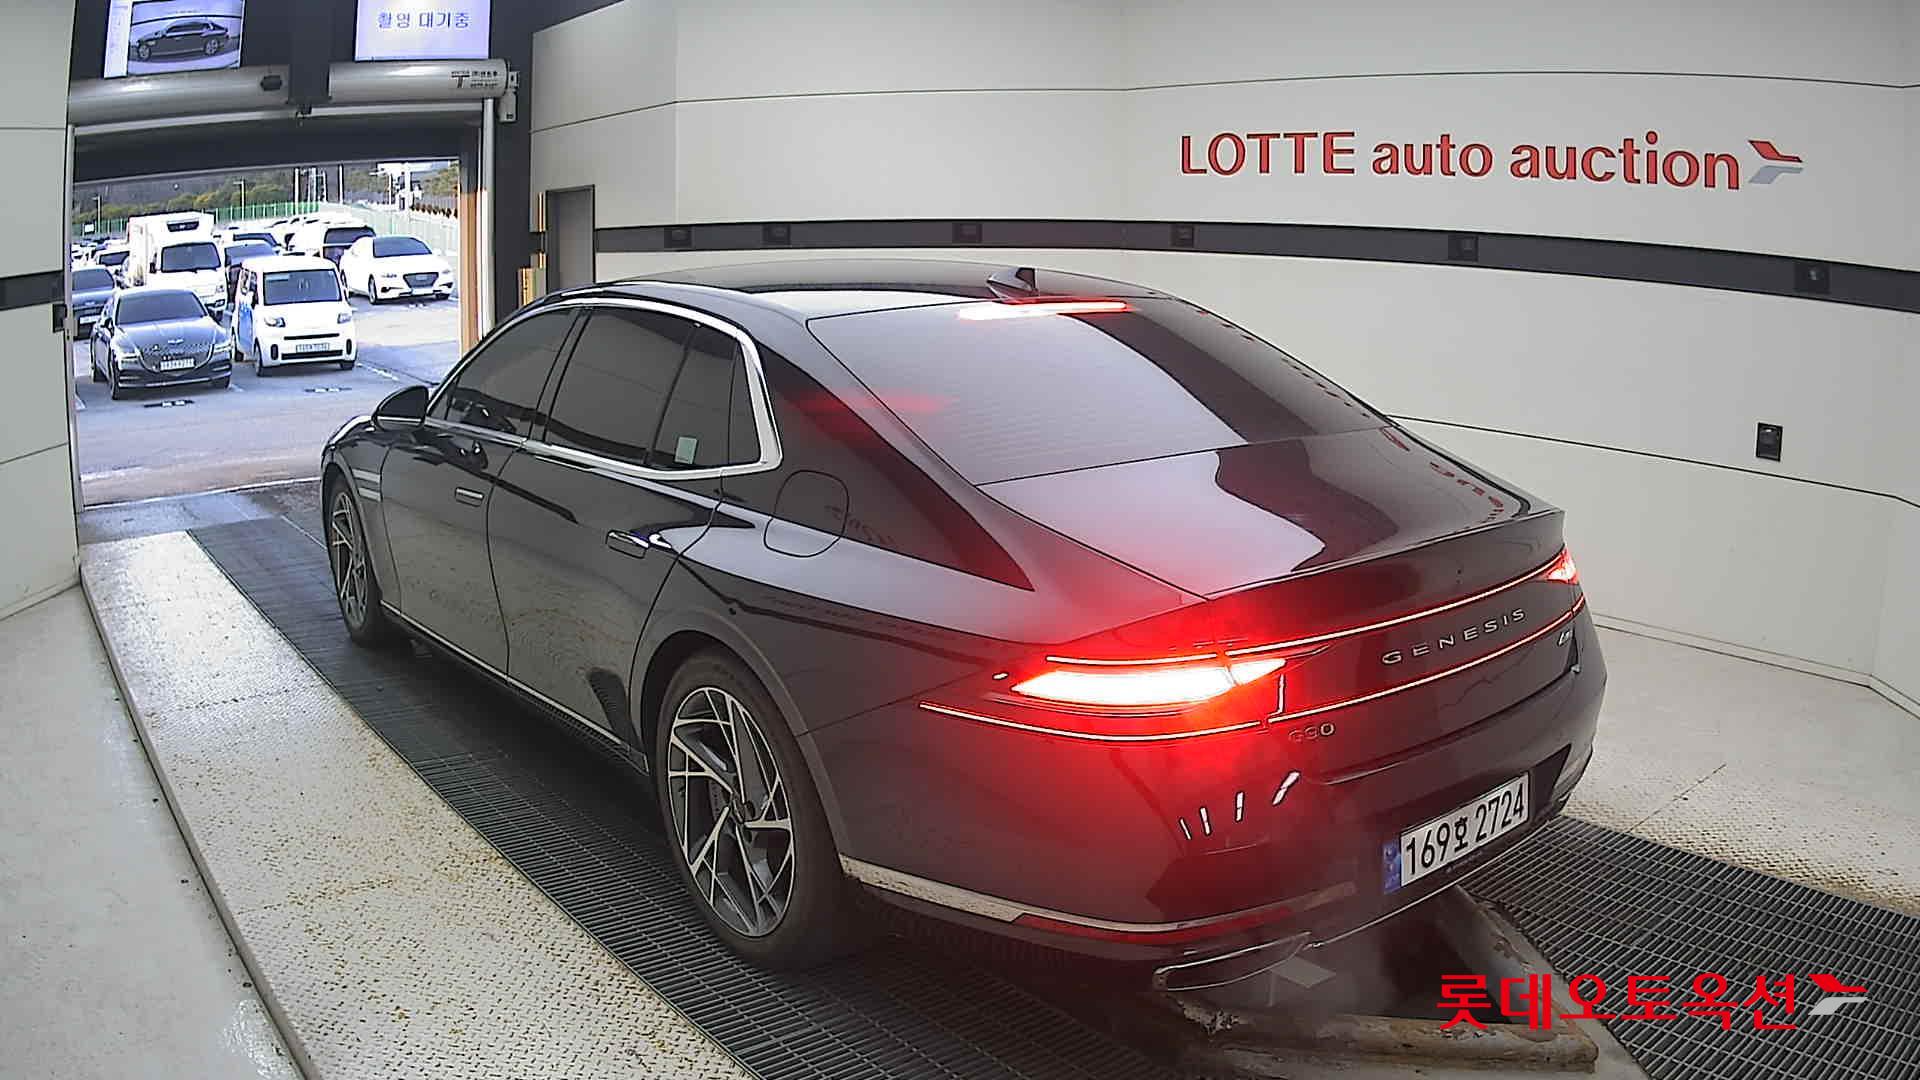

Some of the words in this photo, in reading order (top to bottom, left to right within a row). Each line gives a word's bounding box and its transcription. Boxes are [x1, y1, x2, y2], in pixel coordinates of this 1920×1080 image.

[419, 12, 469, 28] 대기중
[1181, 131, 1355, 176] LOTTE
[1372, 133, 1493, 177] auto
[1510, 131, 1740, 190] auction
[1382, 608, 1526, 664] GENESIS
[1288, 723, 1335, 743] G90
[1405, 816, 1469, 875] 169호
[1475, 783, 1525, 843] 2724
